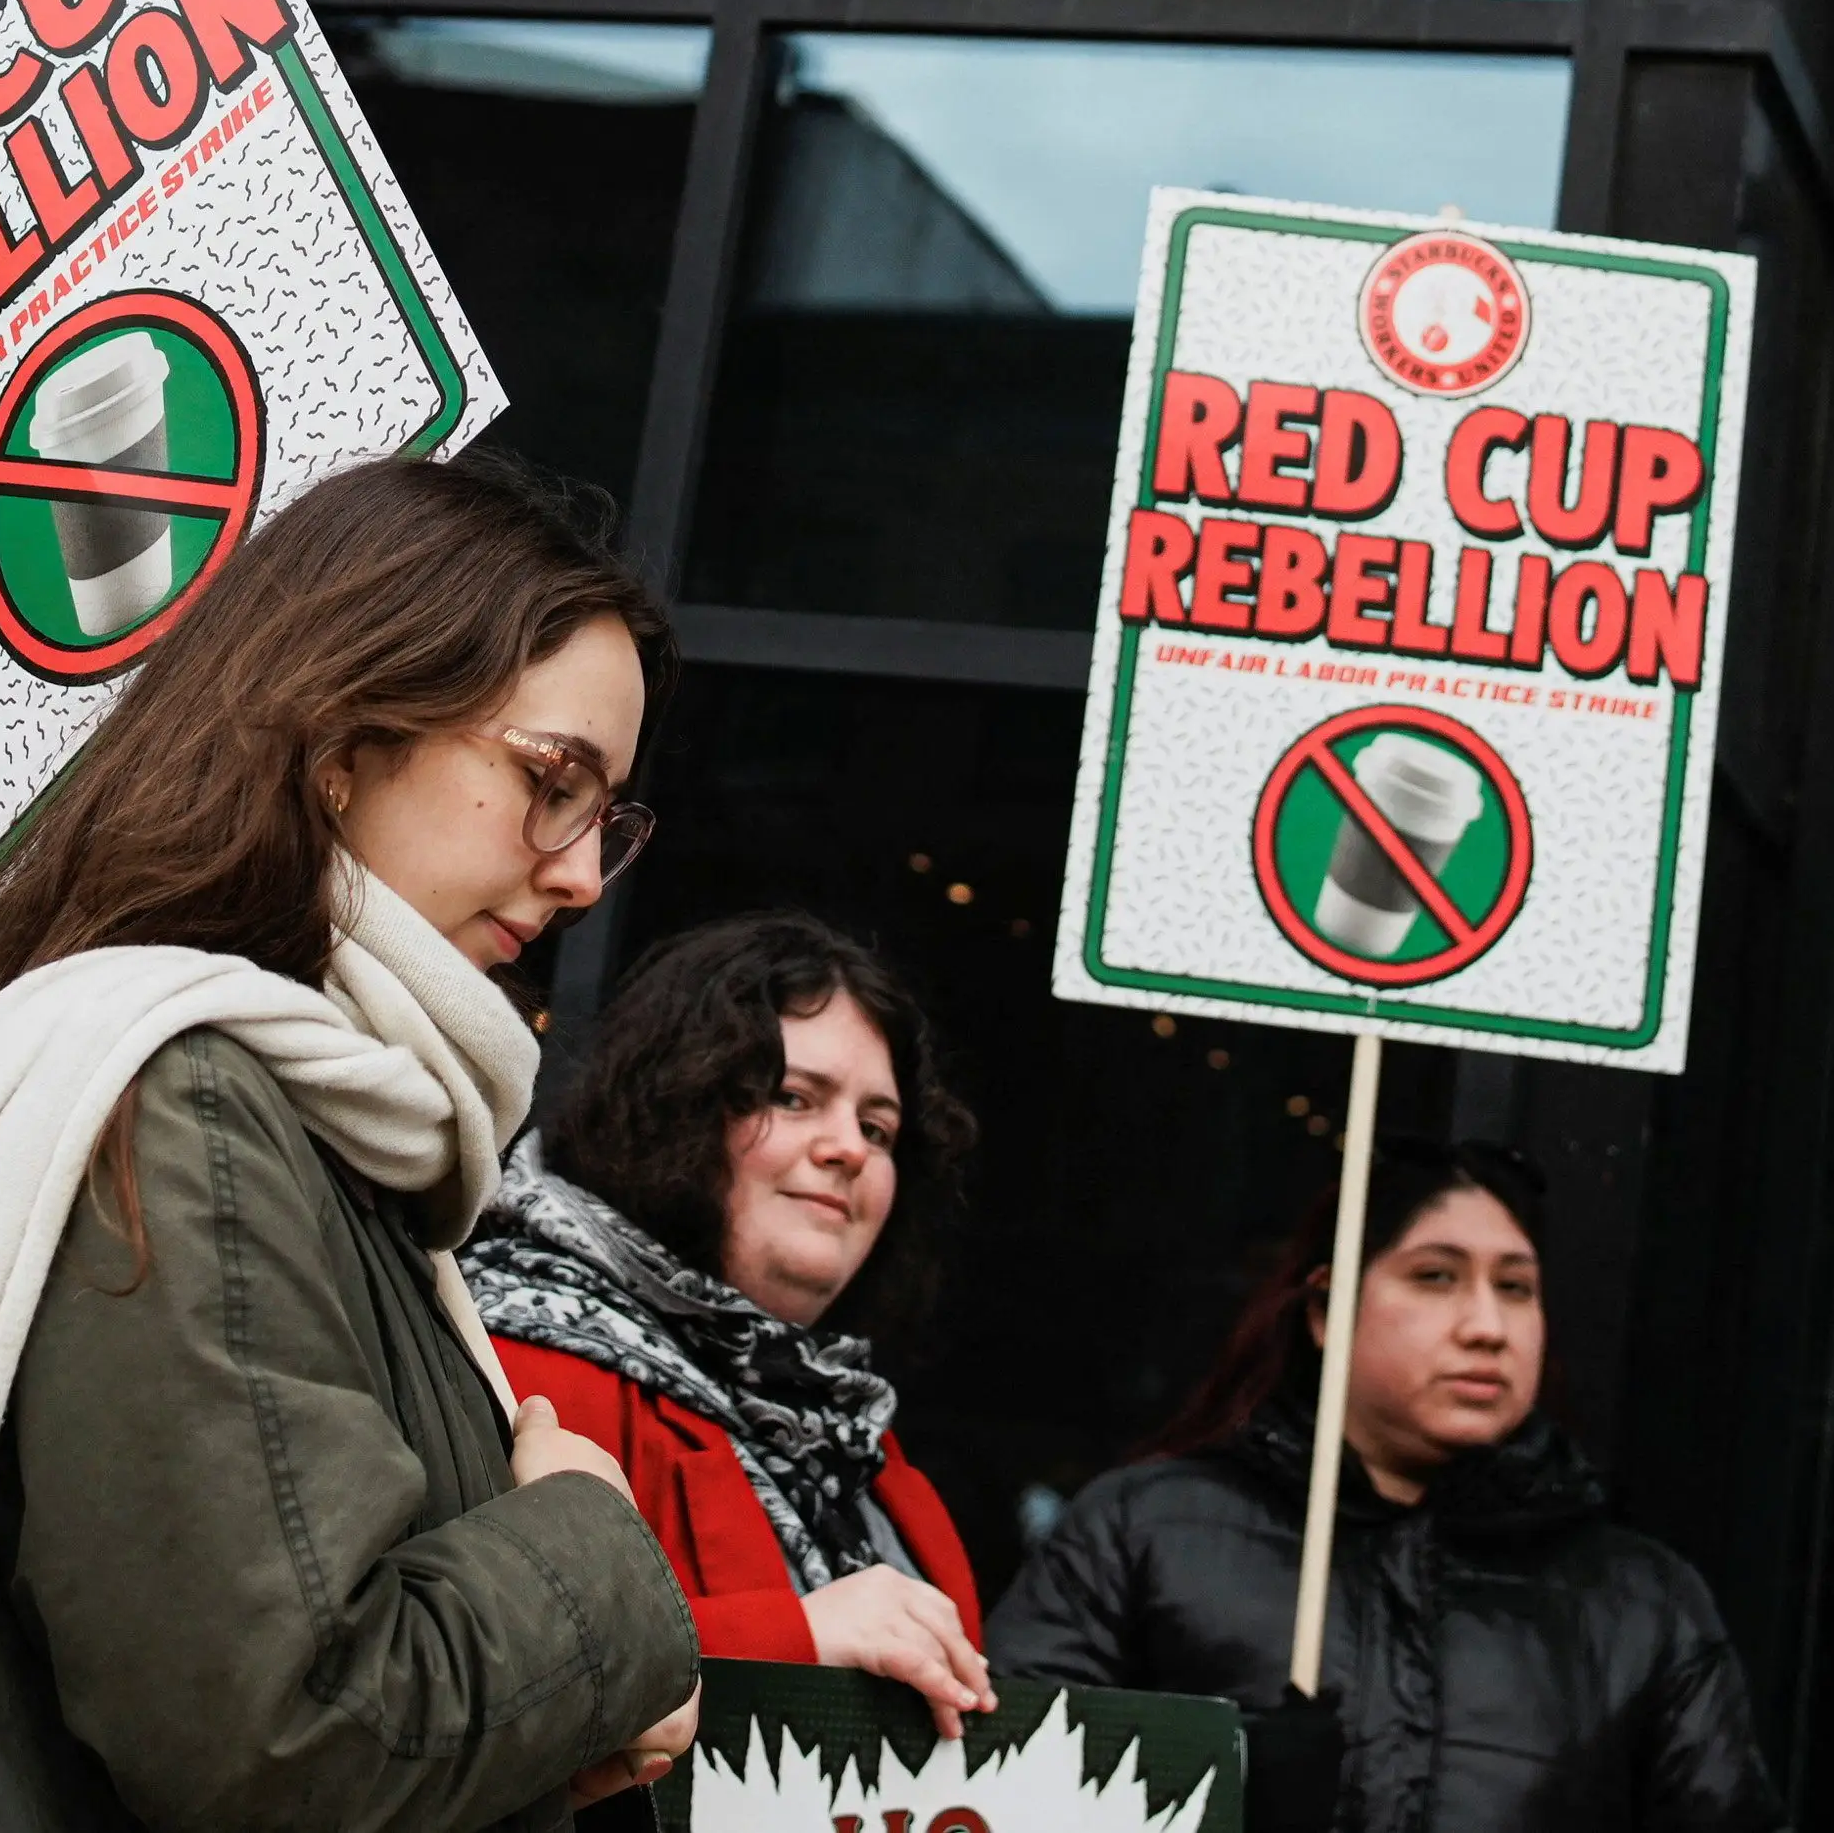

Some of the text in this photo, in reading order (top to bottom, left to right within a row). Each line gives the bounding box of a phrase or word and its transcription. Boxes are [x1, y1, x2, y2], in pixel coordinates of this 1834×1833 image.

[10, 186, 159, 348] PRACTICE
[161, 76, 276, 200] STRIKE
[1388, 243, 1510, 294] STARBUCKS
[1372, 294, 1439, 384] WORKERS
[1457, 310, 1516, 384] UNITED
[1152, 369, 1708, 558] RED CUP
[1119, 507, 1709, 693] REBELLION
[1155, 644, 1659, 720] UNFAIR LABOR PRACTICE STRIKE
